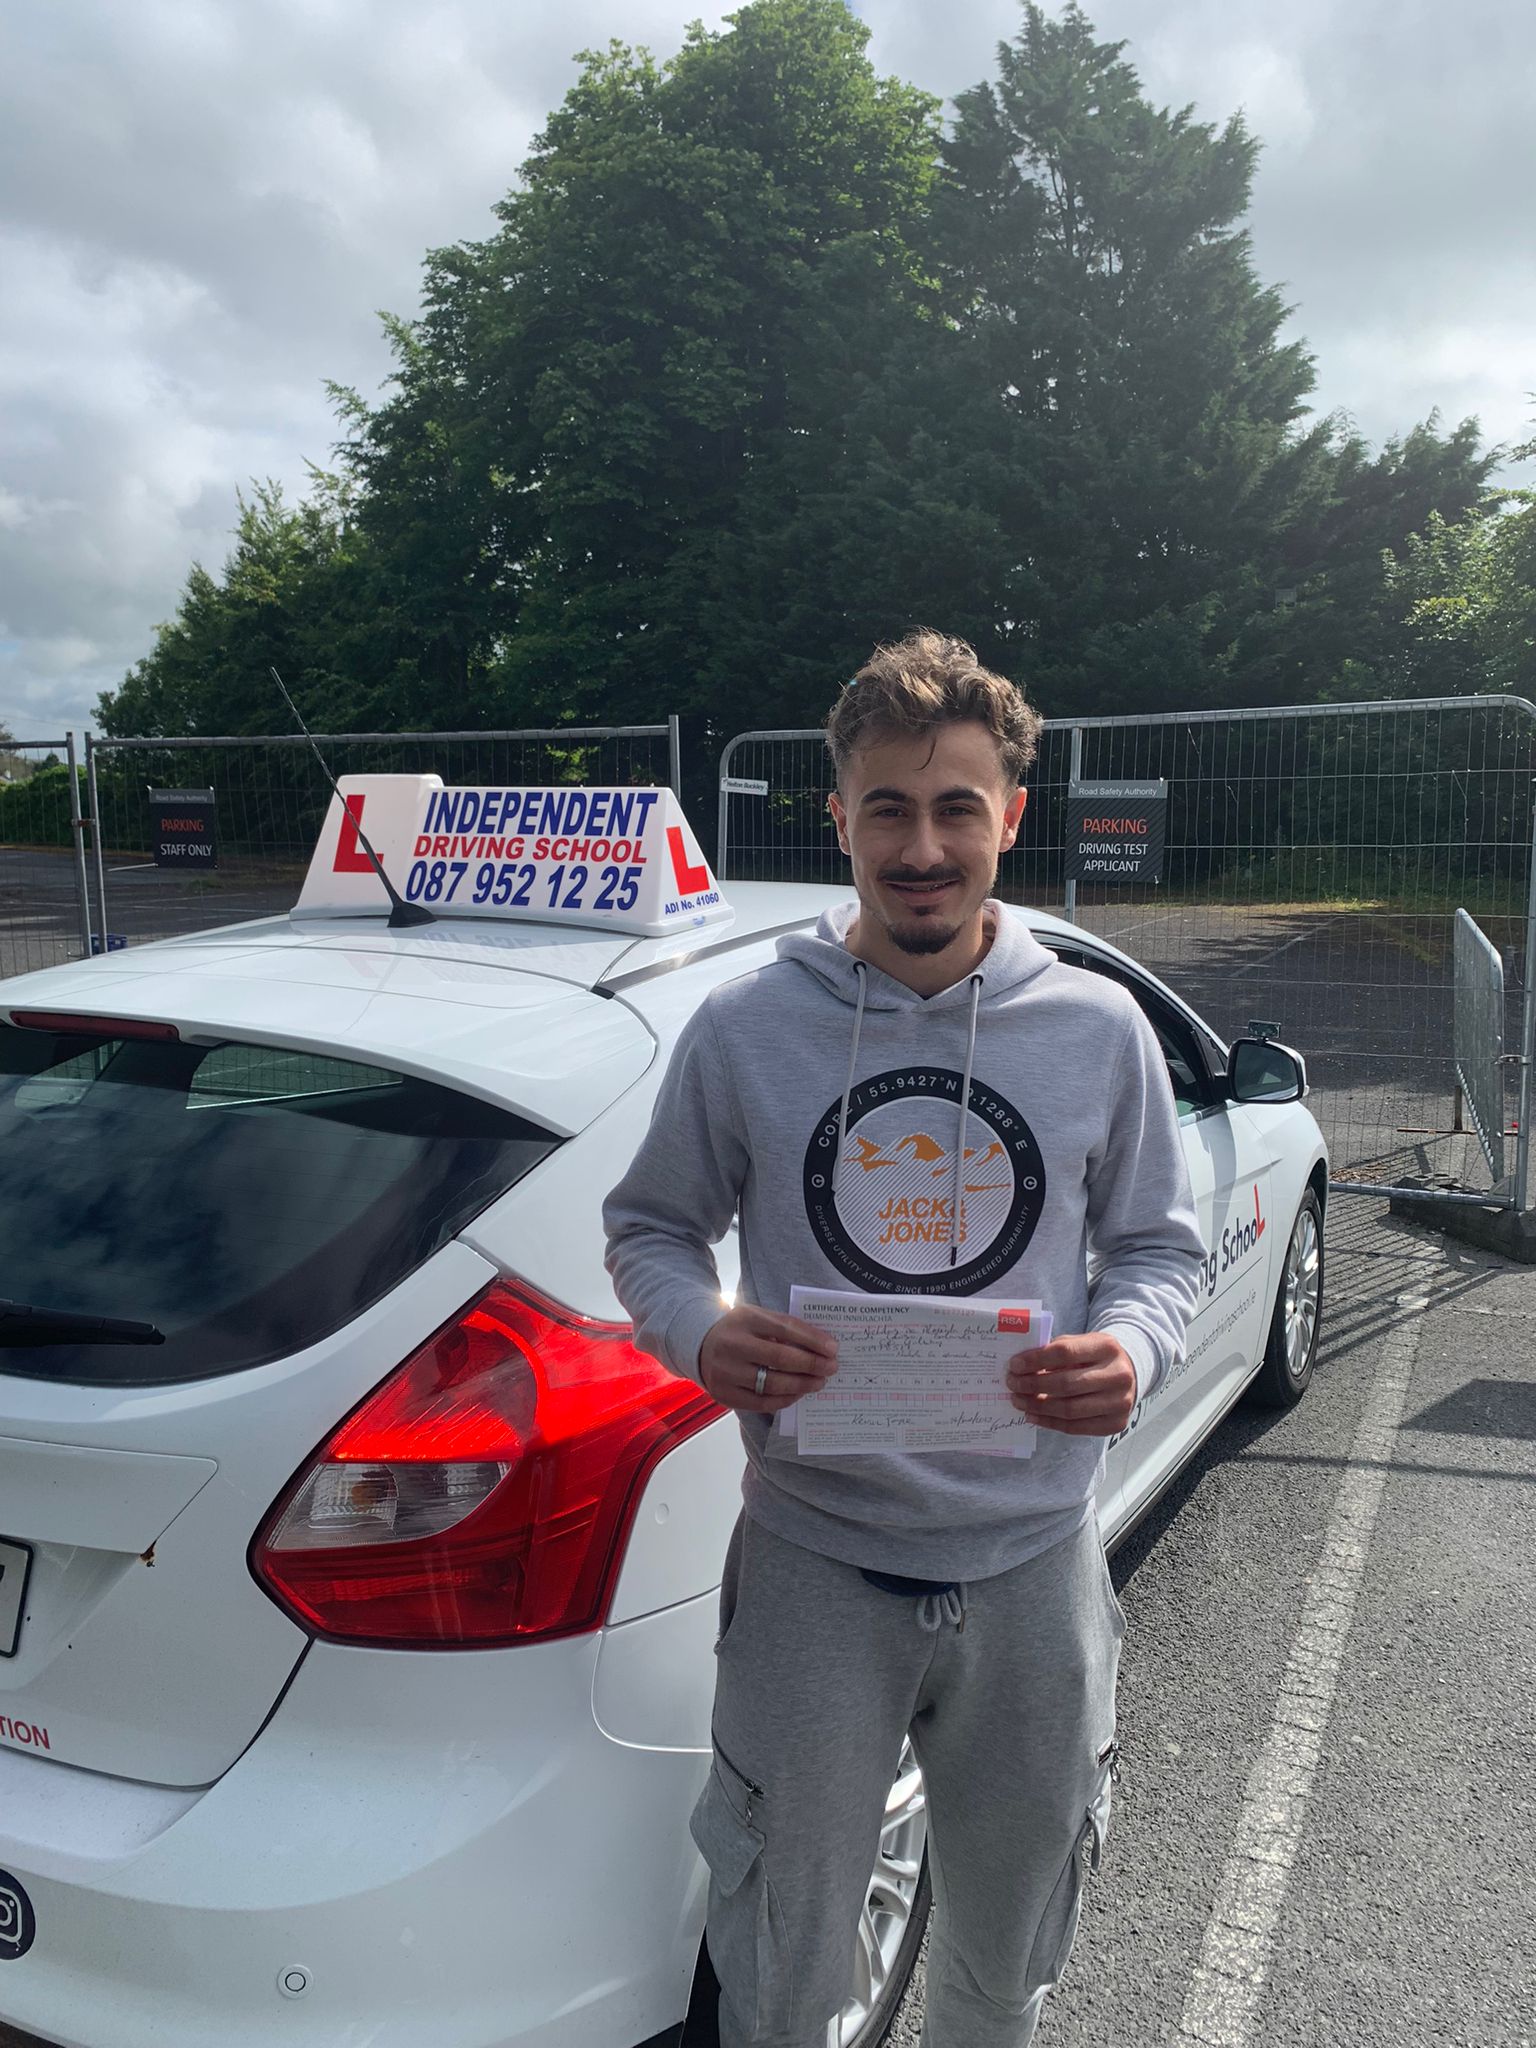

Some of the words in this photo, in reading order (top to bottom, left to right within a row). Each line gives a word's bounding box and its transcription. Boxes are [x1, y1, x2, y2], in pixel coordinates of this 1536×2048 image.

[1078, 788, 1098, 796] Road
[1100, 788, 1122, 797] Safety
[1124, 788, 1157, 797] Authority
[423, 792, 659, 837] INDEPENDENT
[161, 818, 204, 832] PARKING
[1083, 818, 1148, 834] PARKING
[160, 843, 187, 856] STAFF
[188, 844, 212, 857] ONLY
[413, 836, 524, 860] DRIVING
[532, 838, 647, 863] SCHOOL
[1078, 843, 1121, 855] DRIVING
[1123, 843, 1149, 855] TEST
[666, 826, 710, 896] L
[1083, 860, 1141, 872] APPLICANT
[405, 860, 468, 903] 087
[472, 863, 537, 906] 952
[547, 865, 588, 909] 12
[593, 866, 643, 911] 25
[665, 902, 680, 915] ADI
[681, 900, 695, 911] No.
[696, 892, 720, 906] 41060
[815, 1204, 835, 1243] DIVERSE
[833, 1244, 862, 1273] UTILITY
[861, 1271, 893, 1290] ATTIRE
[894, 1285, 922, 1294] SINCE
[925, 1284, 947, 1294] 1990
[949, 1255, 1002, 1290] ENGINEERED
[1001, 1205, 1031, 1256] DURABILITY
[803, 1304, 847, 1313] CERTIFICATE
[860, 1306, 910, 1314] COMPETENCY
[1001, 1317, 1023, 1326] RSA
